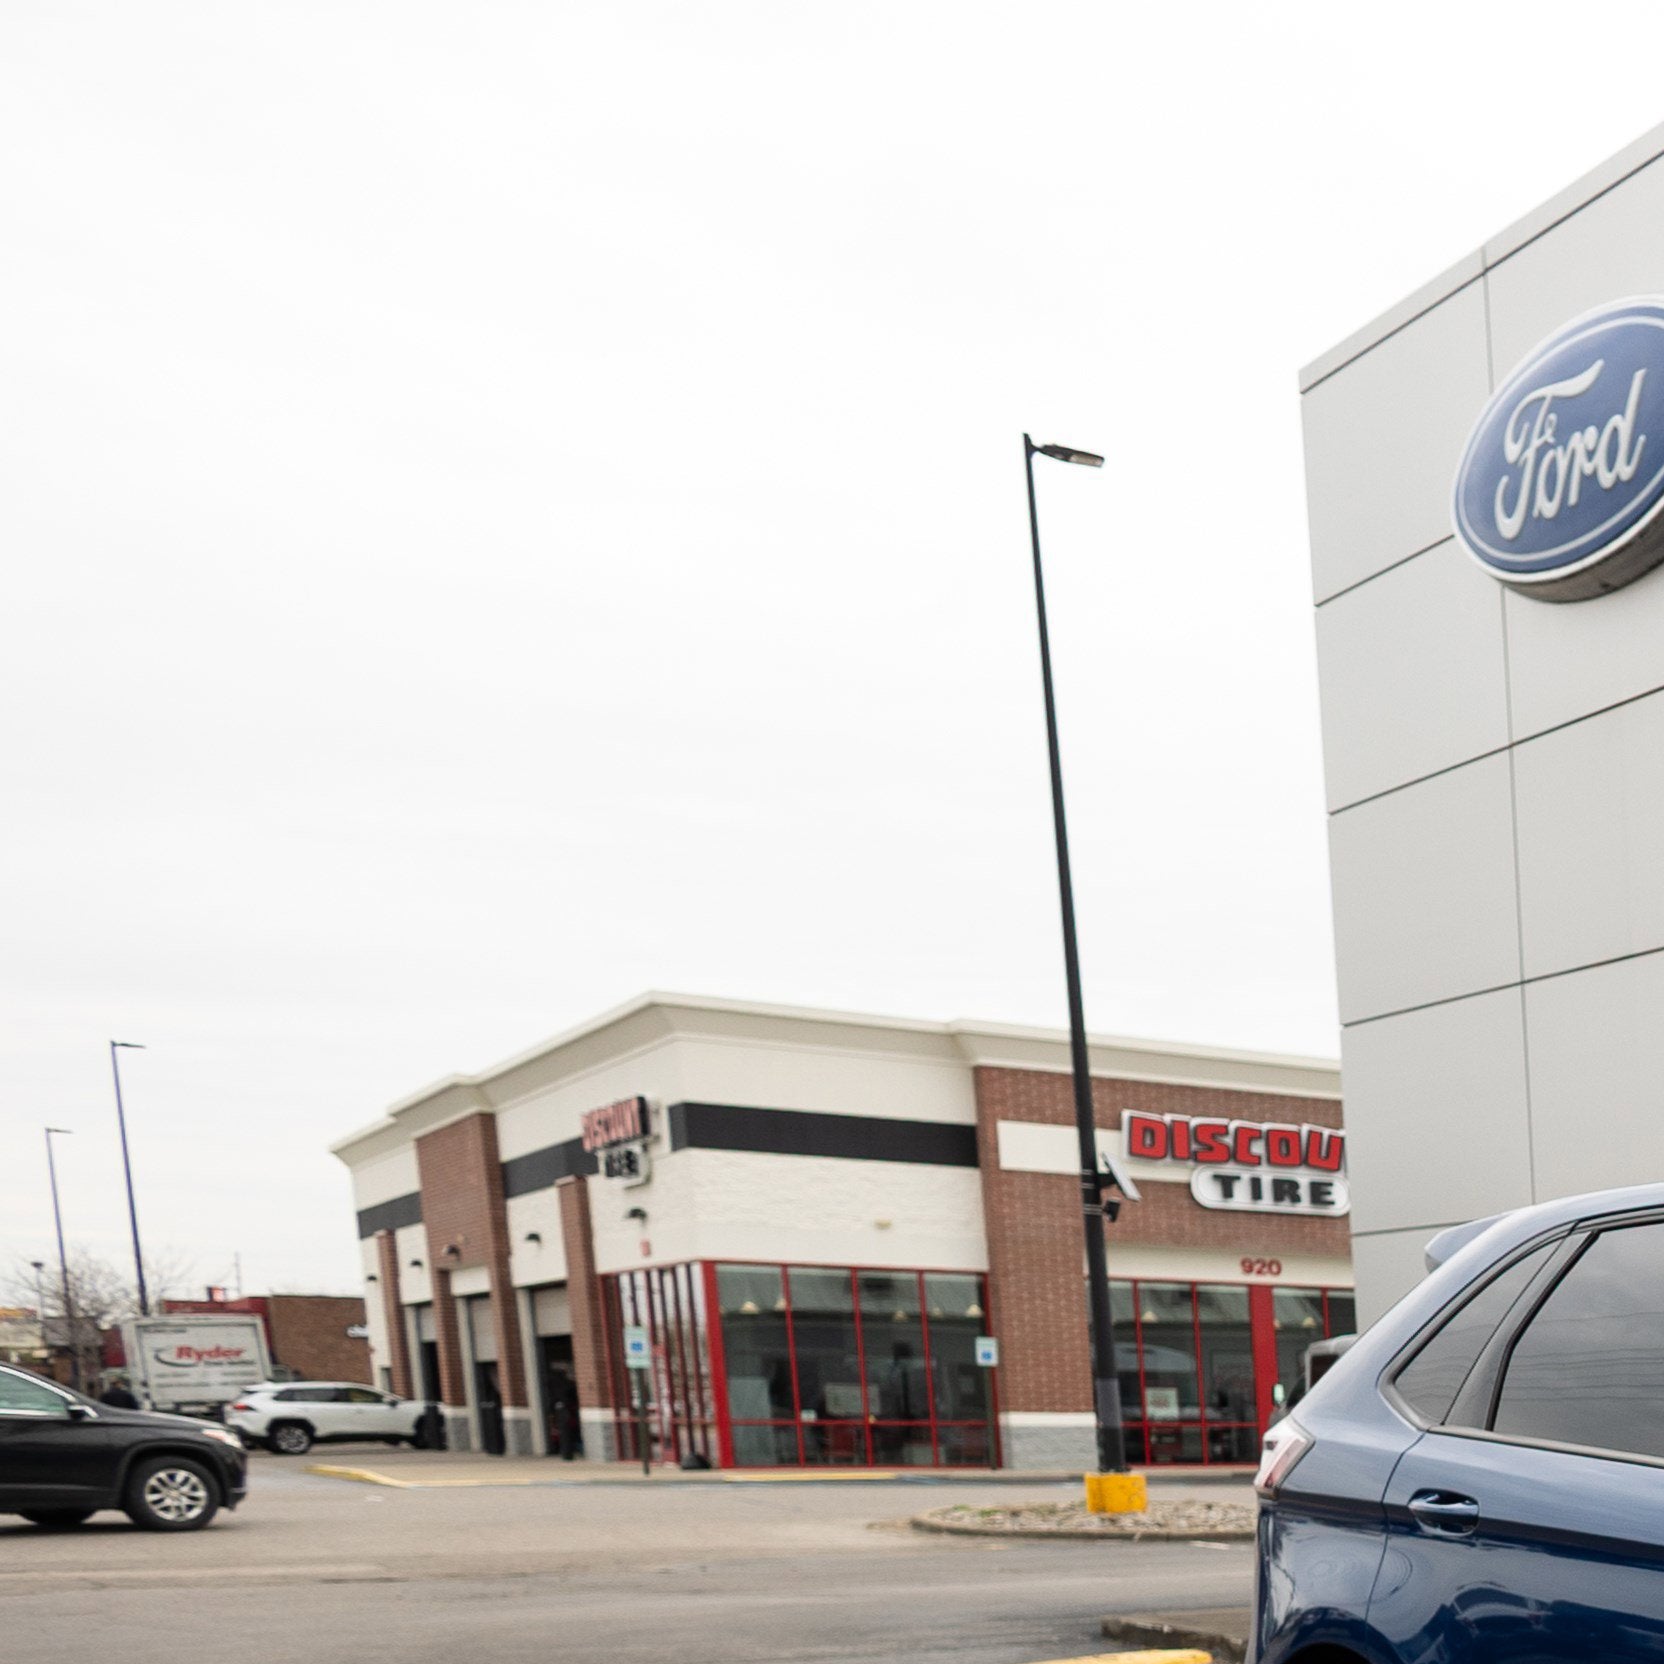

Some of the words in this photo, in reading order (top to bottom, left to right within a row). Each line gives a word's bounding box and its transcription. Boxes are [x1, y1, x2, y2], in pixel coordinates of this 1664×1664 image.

[1494, 358, 1648, 541] Ford
[1211, 1173, 1336, 1206] TIRE
[1240, 1257, 1282, 1276] 920
[175, 1345, 245, 1363] Ryder
